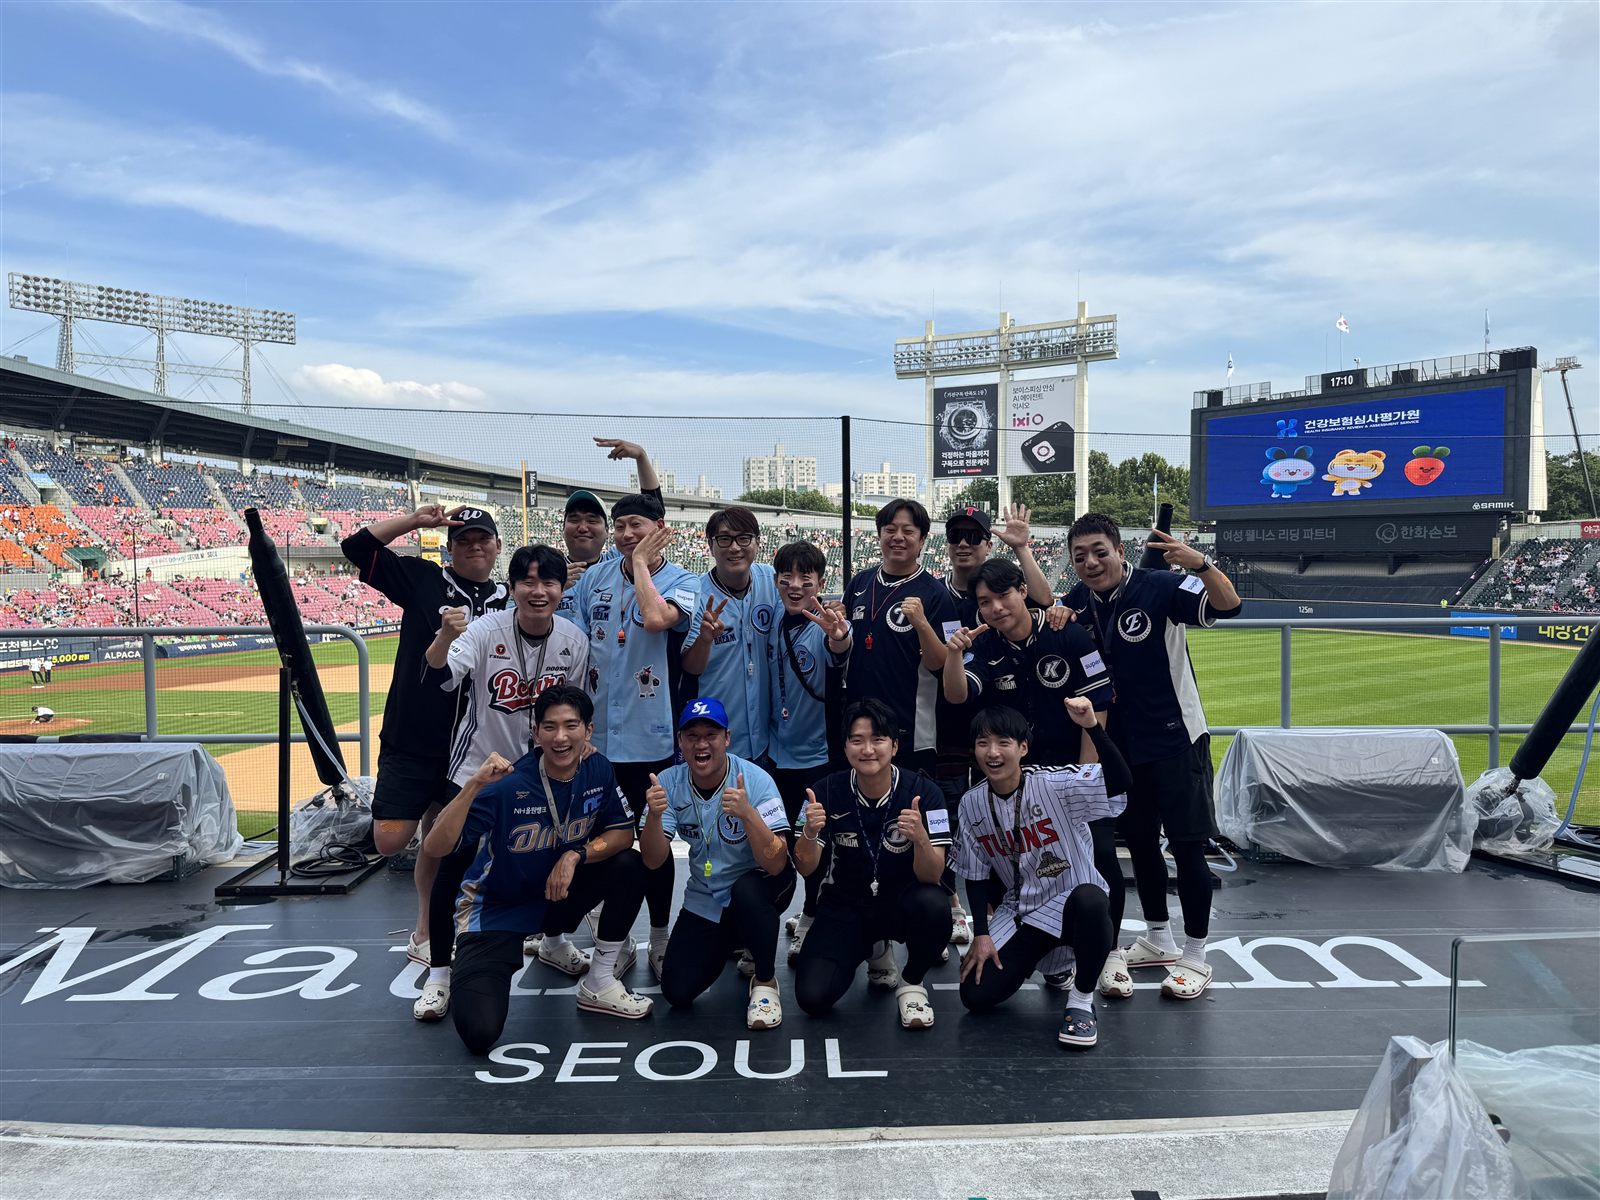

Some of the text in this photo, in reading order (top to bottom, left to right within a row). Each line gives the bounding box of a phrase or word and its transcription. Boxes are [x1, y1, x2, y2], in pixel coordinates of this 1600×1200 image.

[1330, 375, 1354, 387] 17:10
[1304, 409, 1420, 430] 건강보험심사평가원
[1480, 501, 1514, 510] SAMIK
[1222, 527, 1336, 541] 여성 웰니스 리딩 파트너
[1400, 525, 1458, 539] 한화손보
[1298, 605, 1314, 614] 125m
[1125, 611, 1142, 634] E
[211, 641, 238, 649] ALPACA
[104, 650, 142, 660] ALPACA
[1043, 658, 1062, 679] K
[691, 701, 711, 715] SL
[474, 1037, 889, 1085] SEOUL
